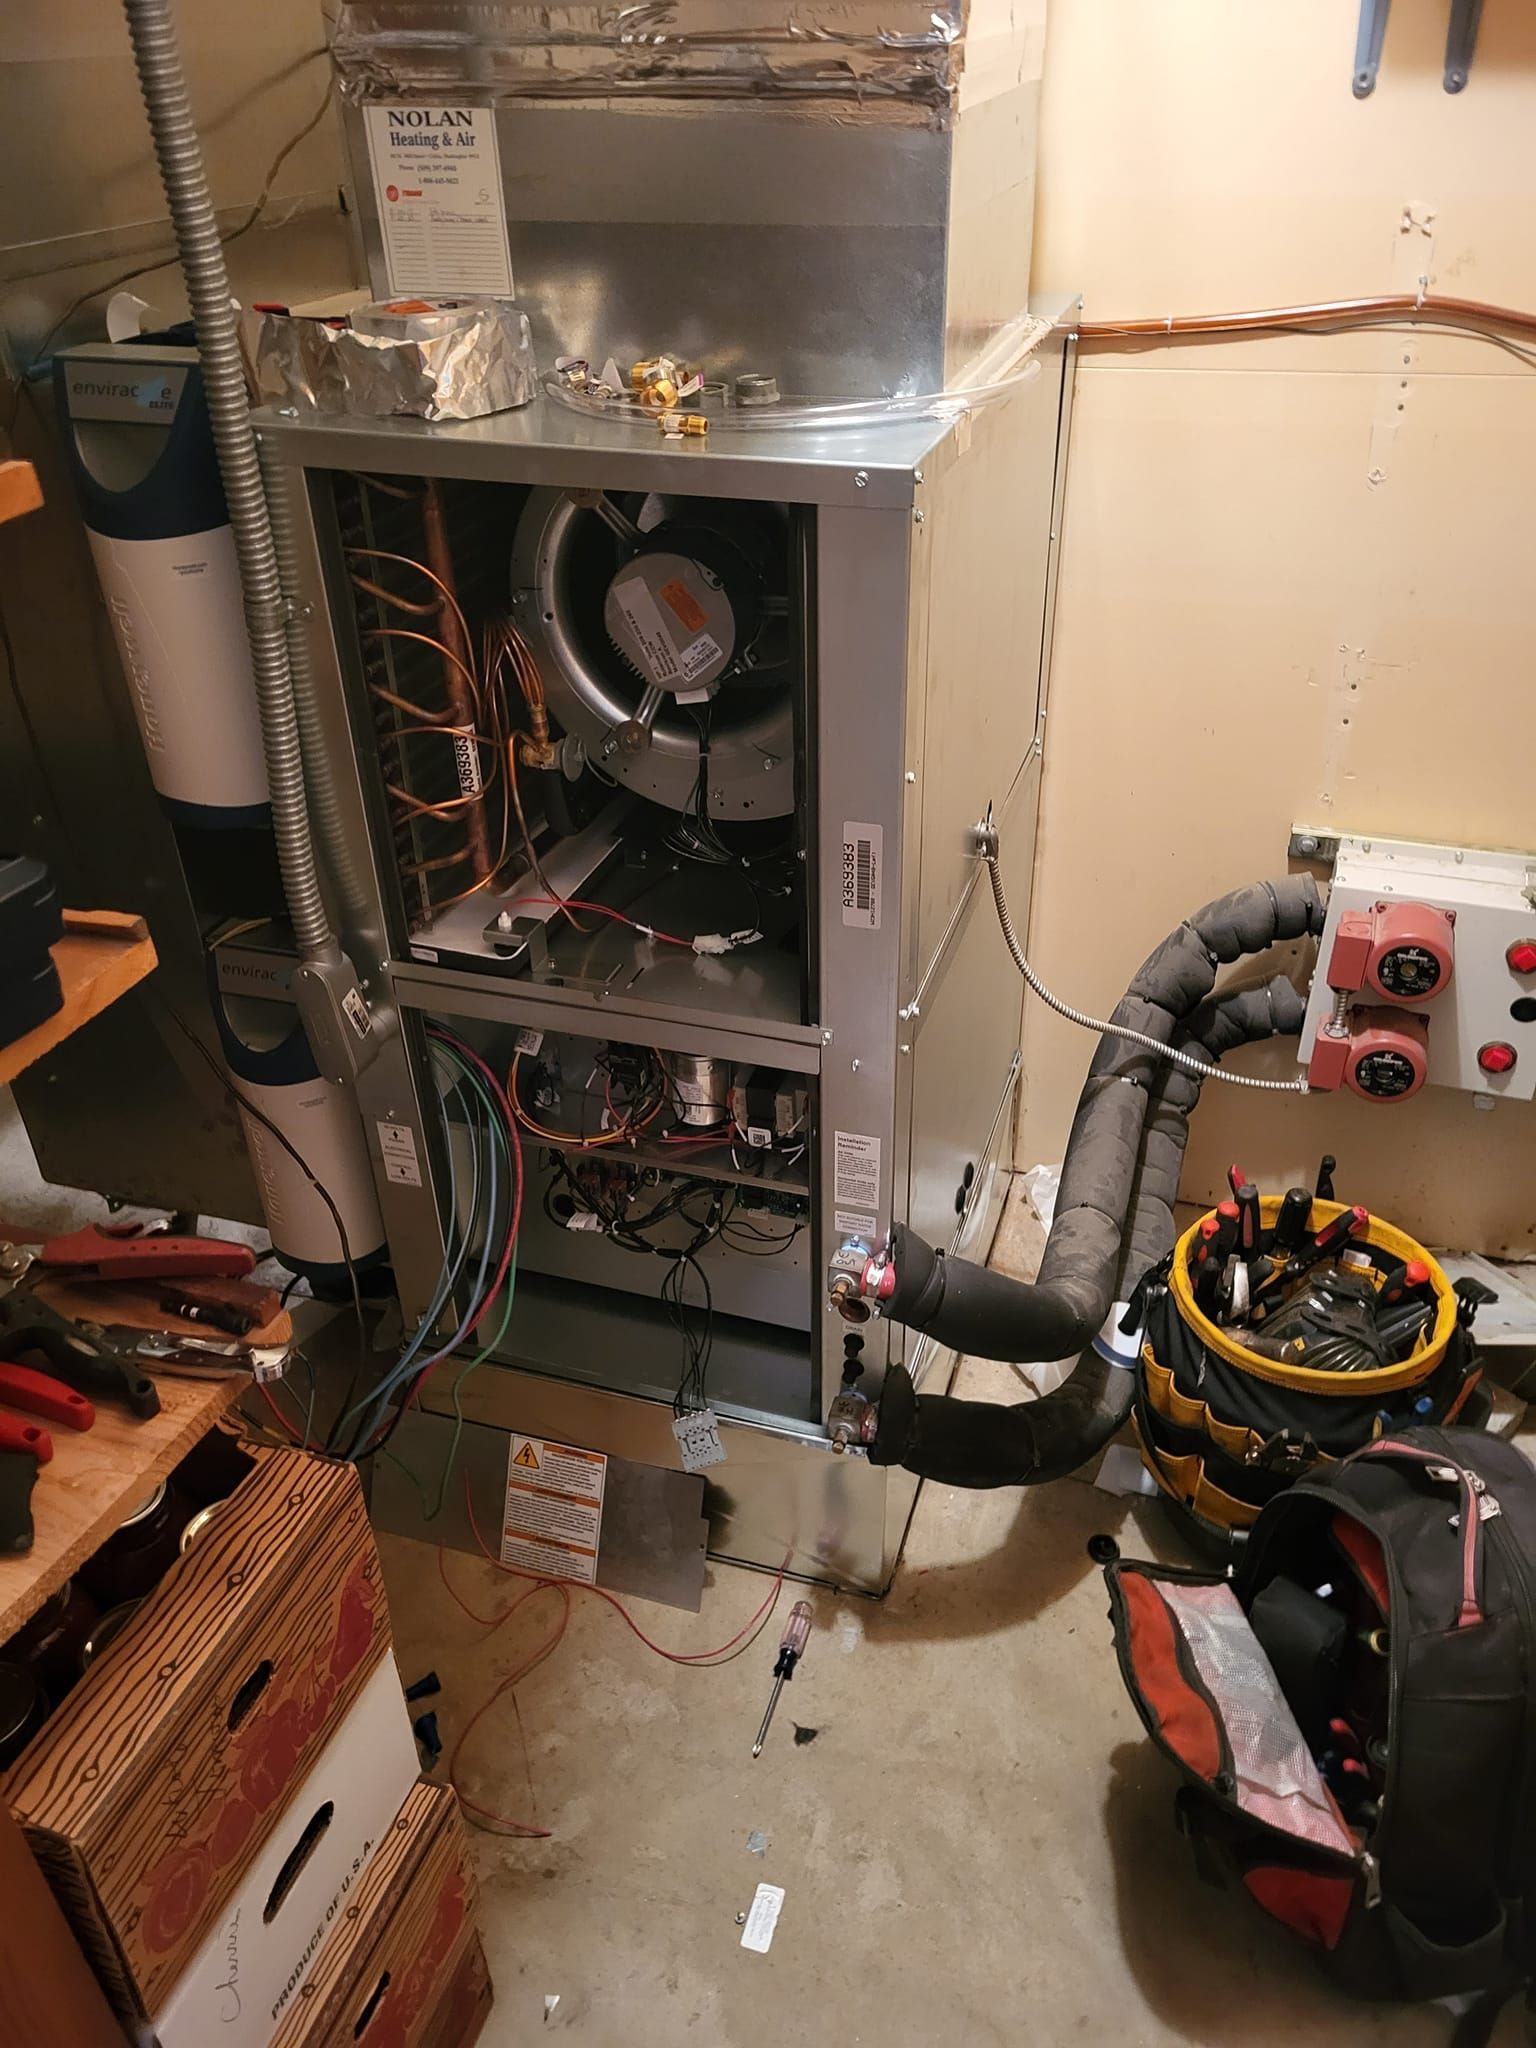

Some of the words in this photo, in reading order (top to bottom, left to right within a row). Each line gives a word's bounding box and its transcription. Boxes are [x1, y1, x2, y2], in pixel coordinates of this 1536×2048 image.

[387, 110, 473, 127] NOLAN
[390, 131, 439, 150] Heating
[442, 133, 452, 146] &
[456, 132, 476, 147] Air
[455, 735, 475, 793] A369383
[843, 843, 854, 907] A369383
[837, 1135, 871, 1146] Installation
[837, 1141, 867, 1152] Reminder
[271, 1922, 324, 2021] PRODUCE
[326, 1893, 340, 1922] OF
[341, 1838, 375, 1893] U.S.A.
